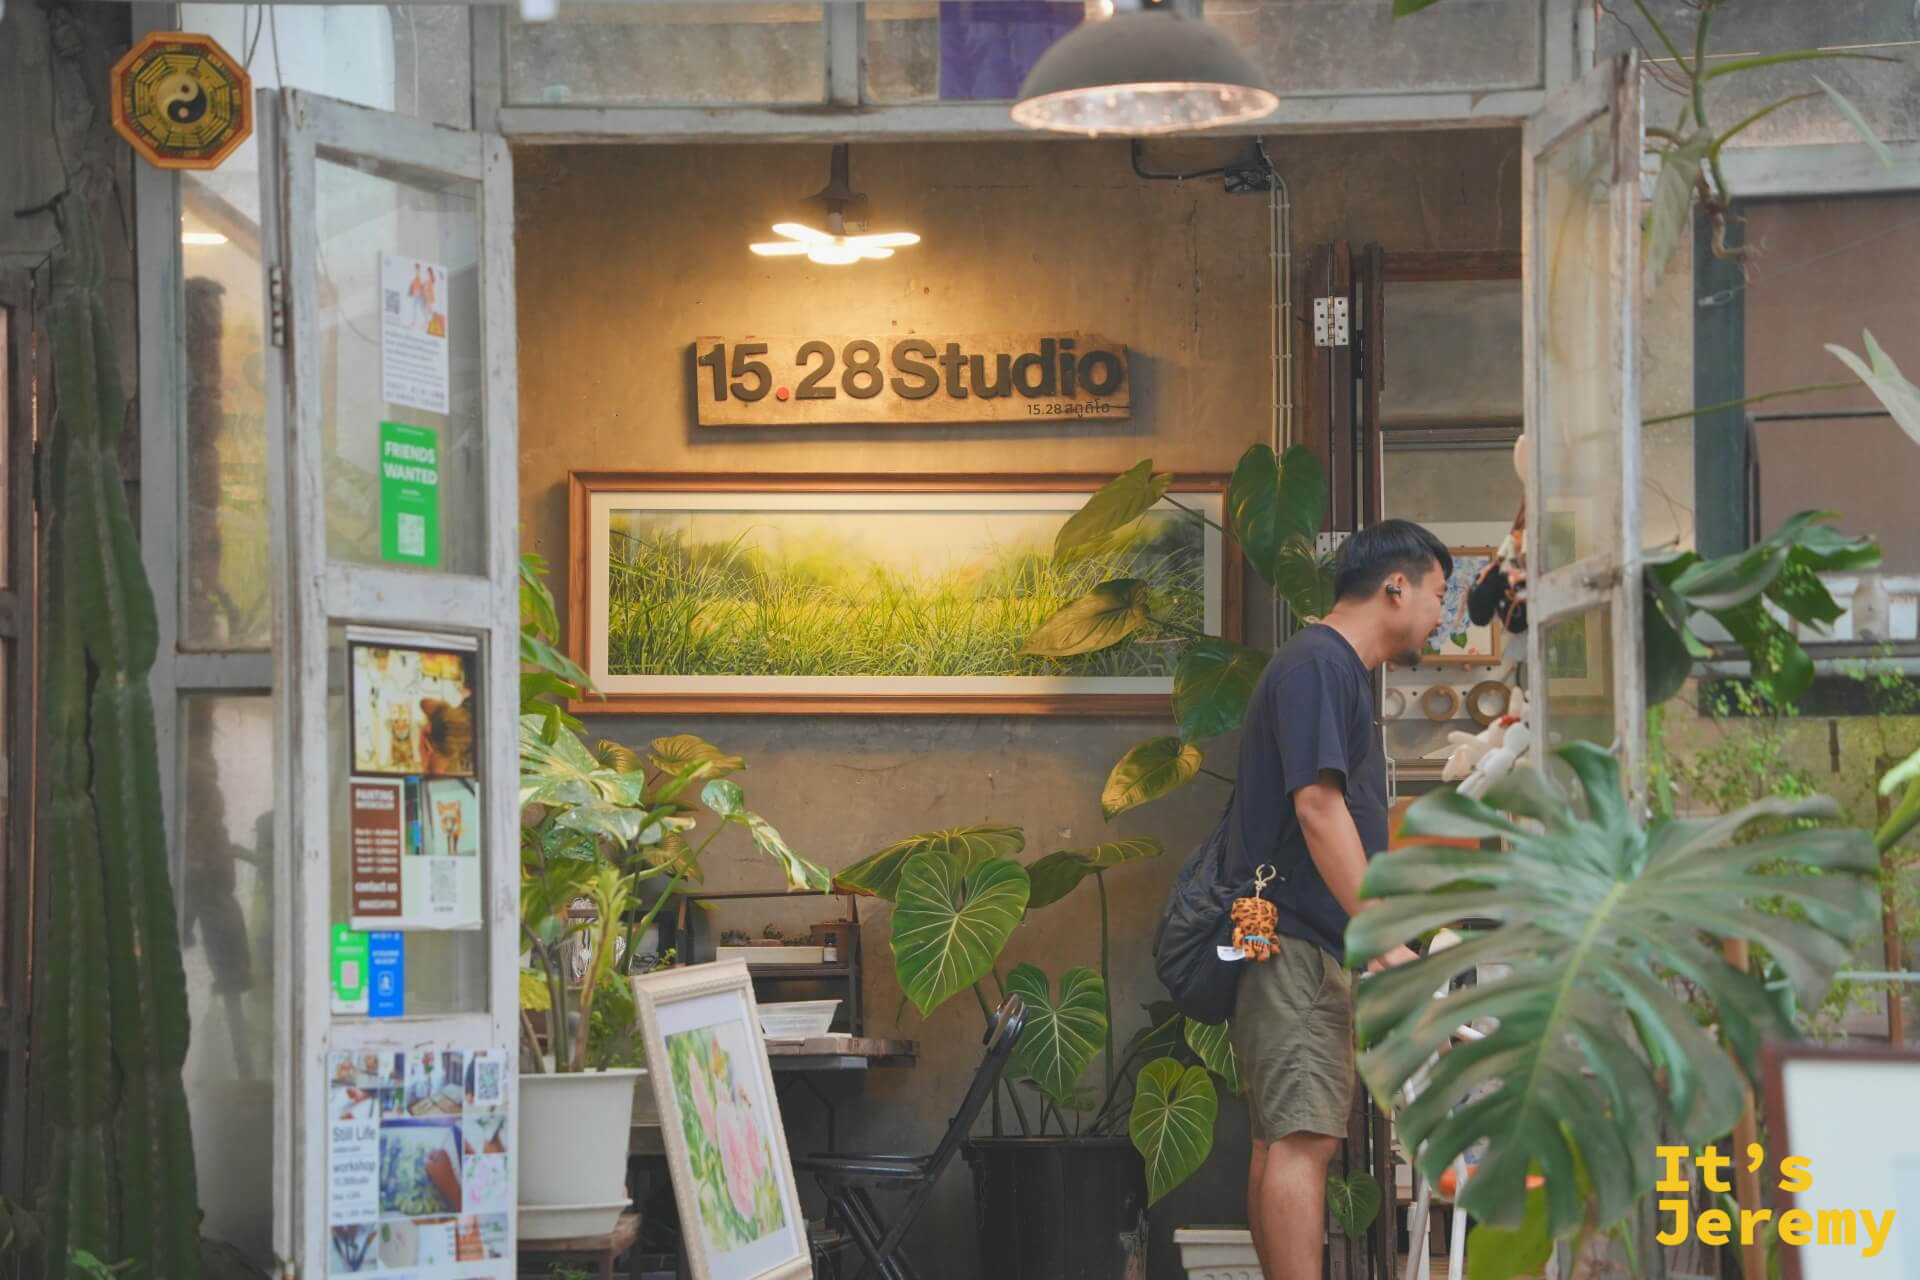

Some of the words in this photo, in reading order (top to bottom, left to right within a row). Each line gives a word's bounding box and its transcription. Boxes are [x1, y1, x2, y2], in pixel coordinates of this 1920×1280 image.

[384, 440, 437, 464] FRIENDS
[383, 462, 439, 486] WANTED
[333, 1125, 354, 1142] Still
[356, 1124, 376, 1141] Life
